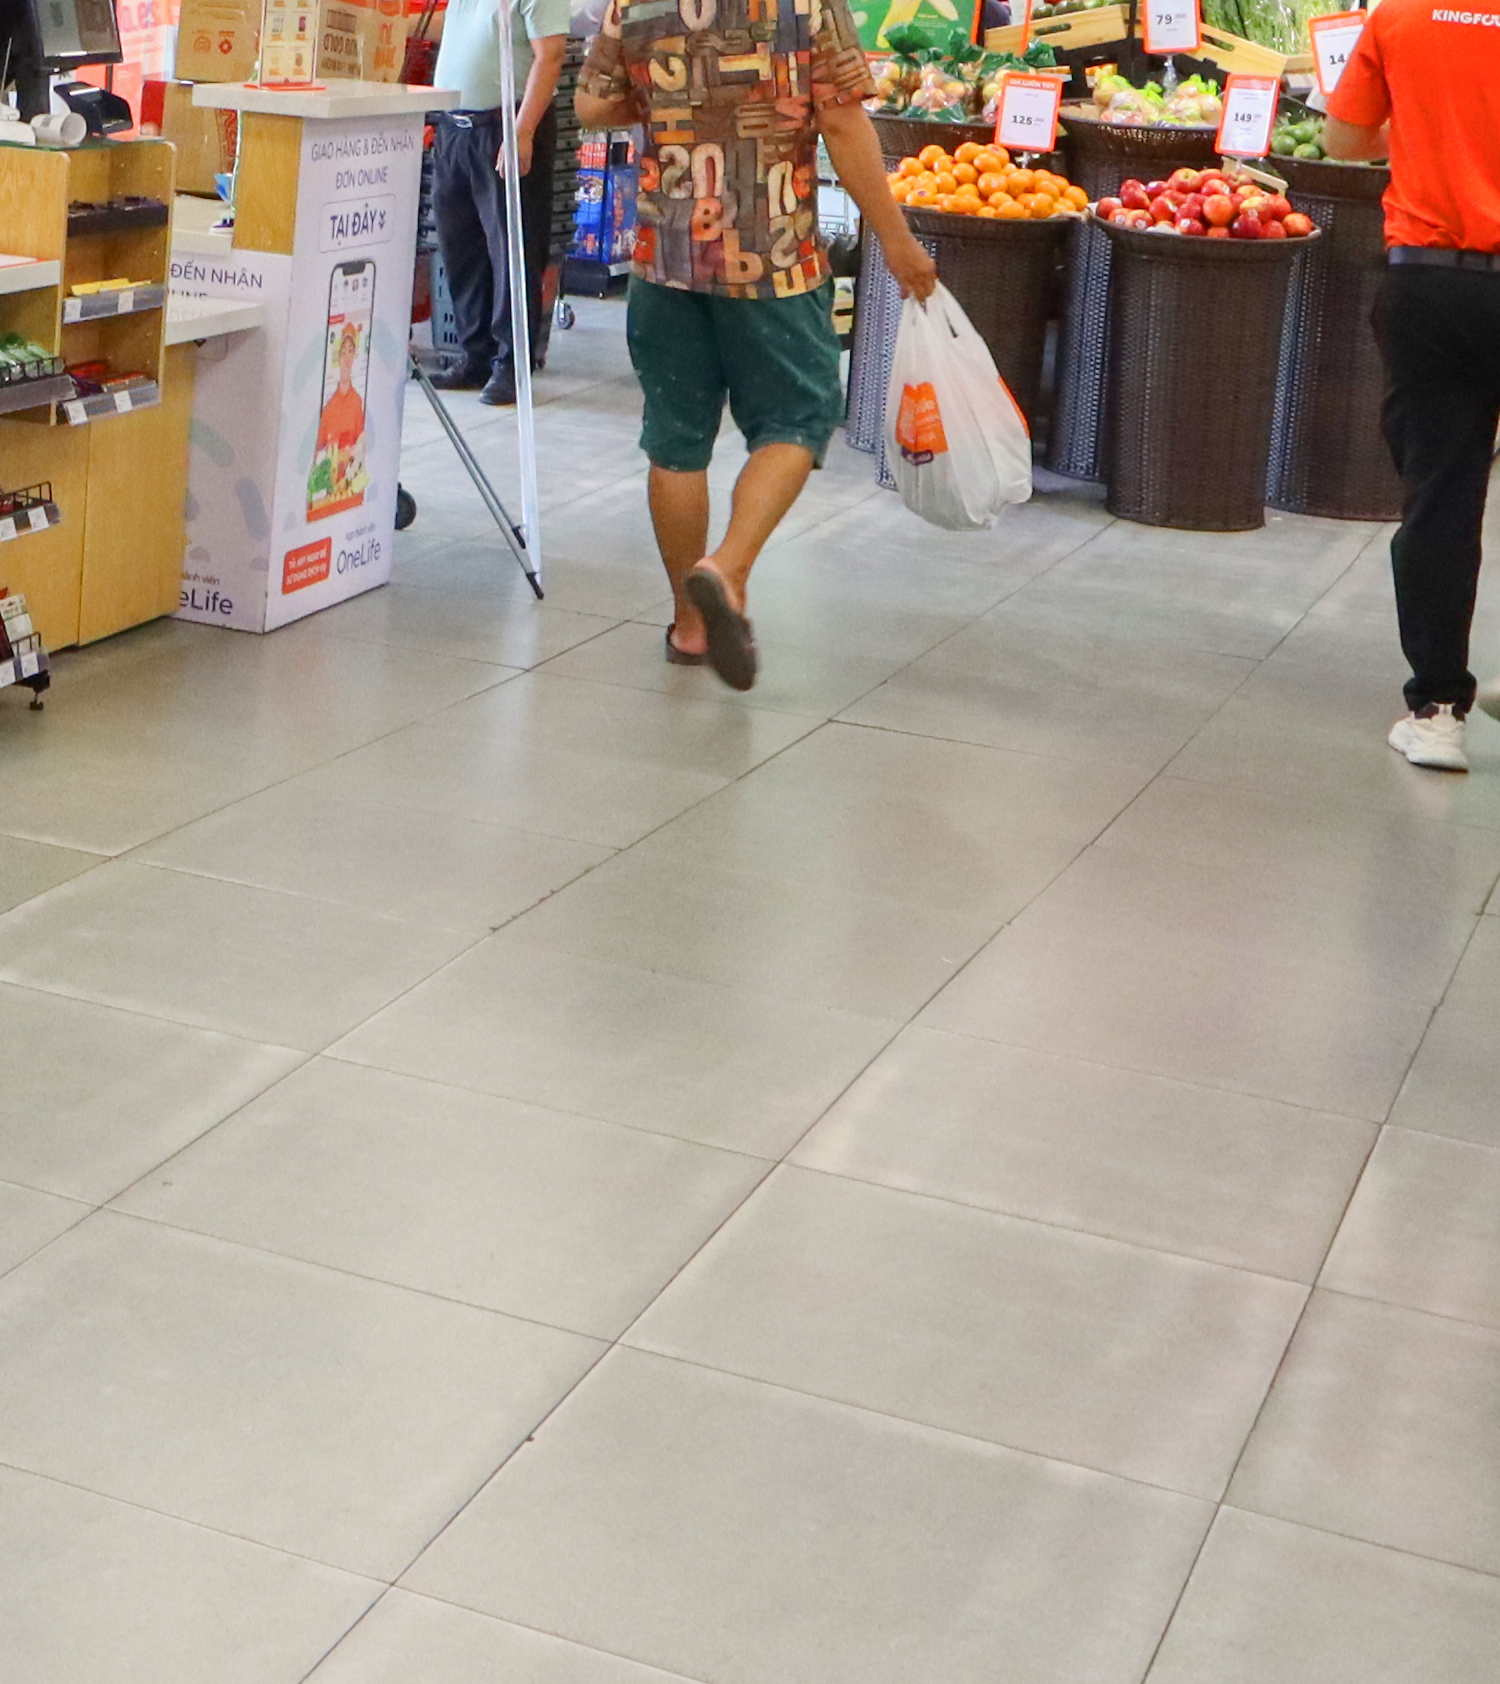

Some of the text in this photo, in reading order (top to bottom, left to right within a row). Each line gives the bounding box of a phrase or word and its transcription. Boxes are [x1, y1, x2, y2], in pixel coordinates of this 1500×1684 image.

[312, 137, 414, 162] GIAO HÀNG ĐẾN NHẬN
[334, 166, 389, 190] ĐƠN ONLINE
[329, 206, 378, 247] TẠI ĐÂY
[170, 259, 264, 290] ĐẾN NHẬN
[336, 535, 381, 575] OneLife
